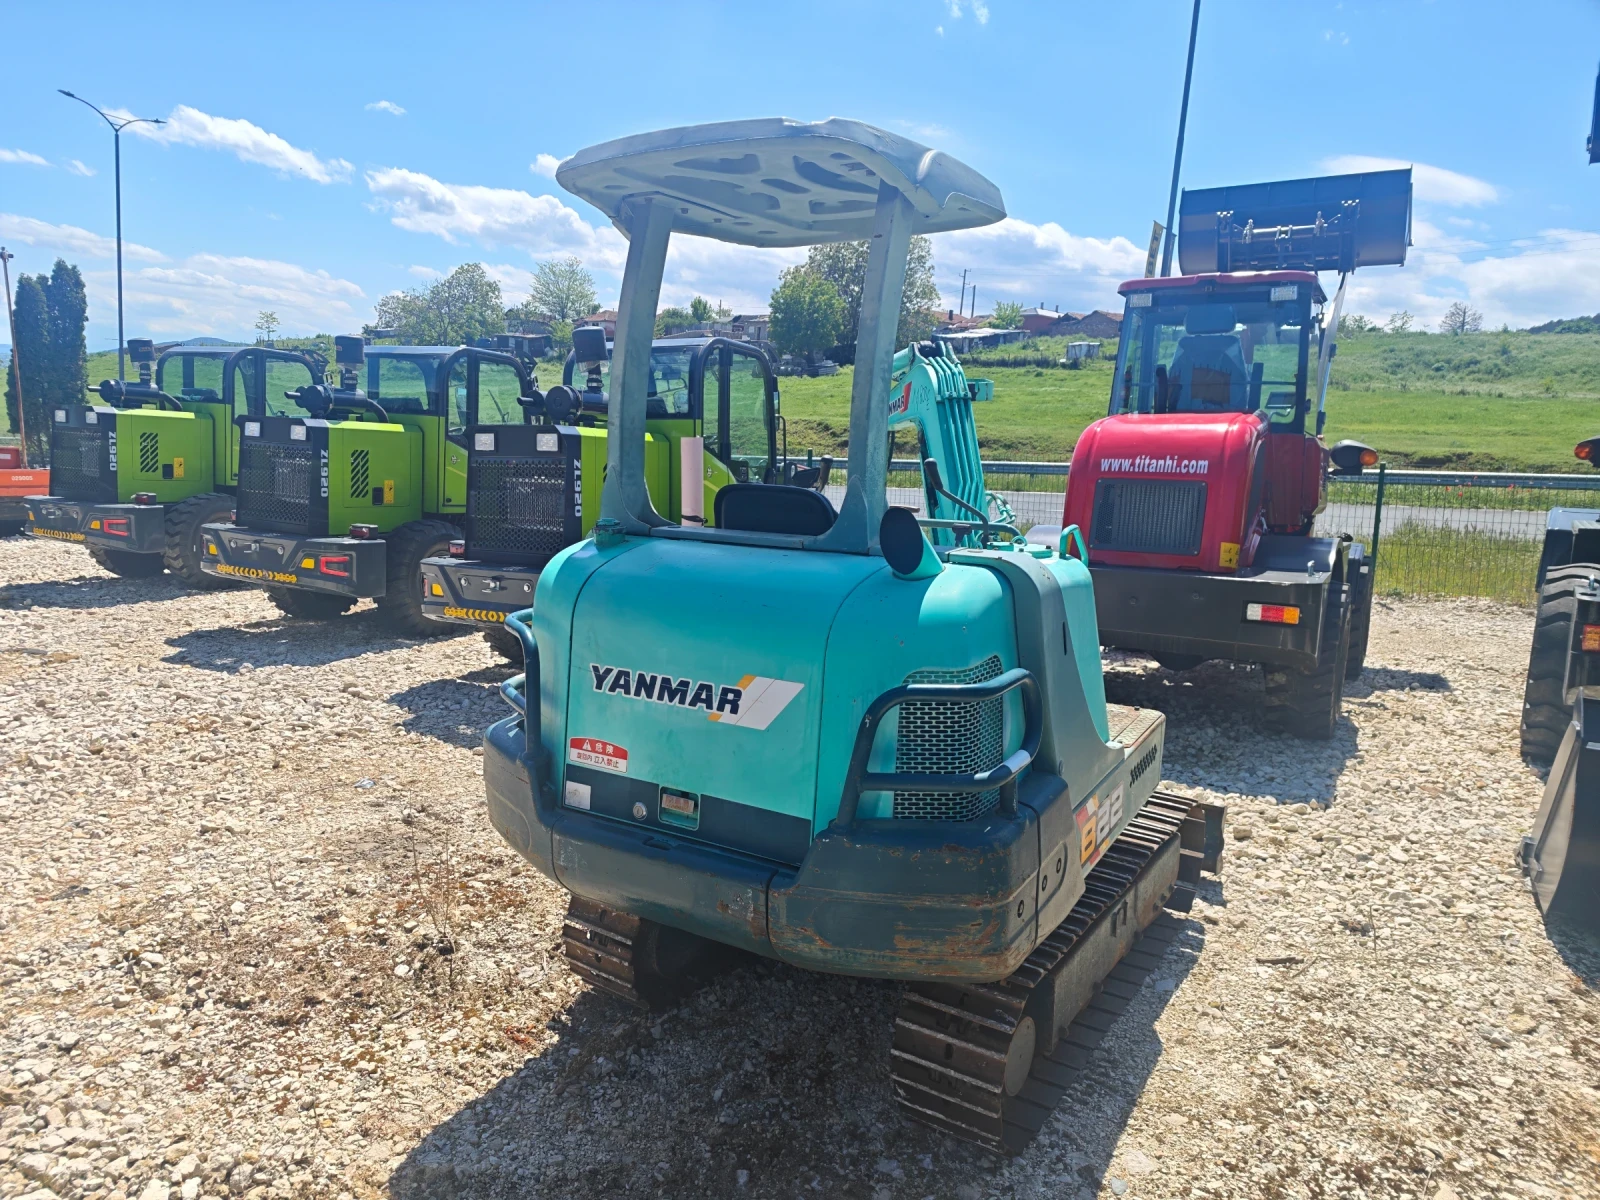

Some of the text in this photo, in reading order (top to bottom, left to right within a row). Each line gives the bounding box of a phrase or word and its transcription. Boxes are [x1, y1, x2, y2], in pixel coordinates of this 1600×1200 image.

[888, 393, 905, 417] NMAR
[108, 431, 117, 471] ZL920
[1100, 455, 1209, 474] www.titanhi.com
[320, 449, 329, 498] ZL920
[573, 458, 582, 517] ZL920
[590, 664, 743, 716] YANMAR
